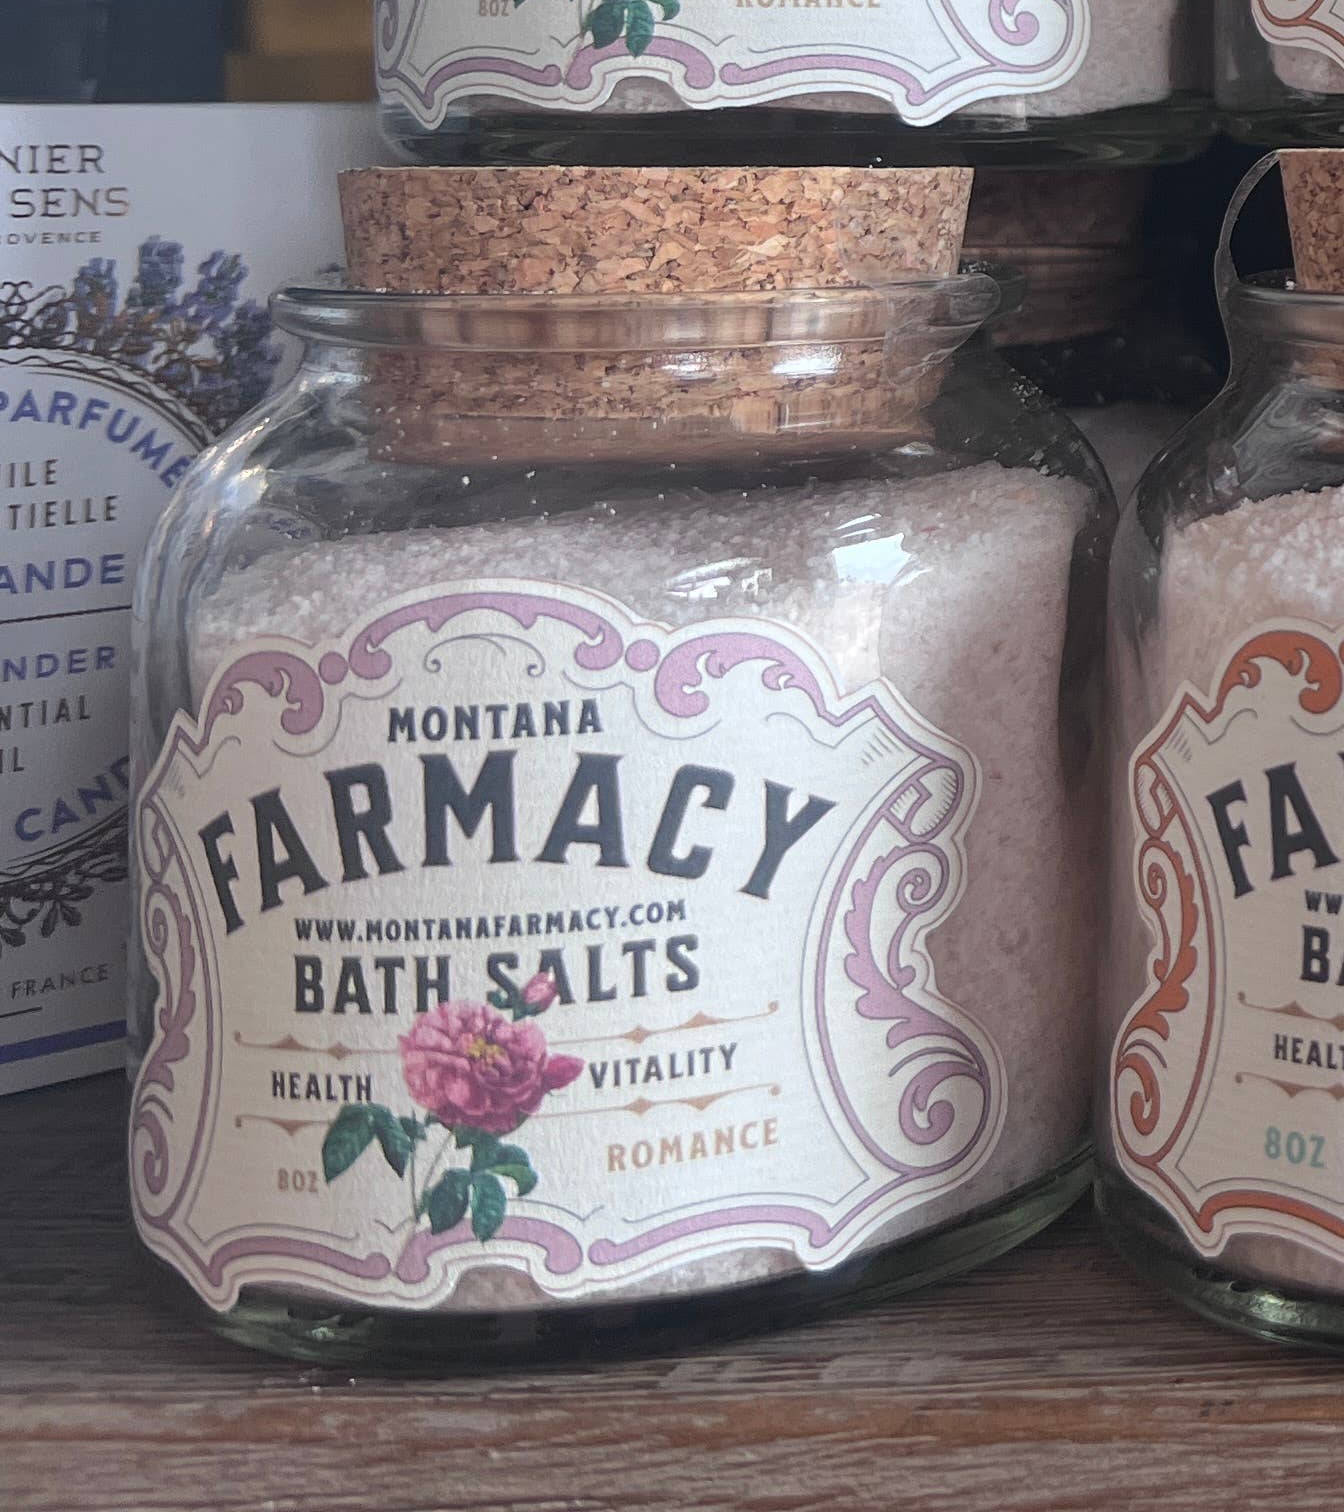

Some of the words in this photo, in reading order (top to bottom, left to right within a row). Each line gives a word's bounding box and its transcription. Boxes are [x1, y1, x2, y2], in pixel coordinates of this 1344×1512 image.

[10, 187, 130, 218] SENS
[0, 231, 102, 244] OVENCE
[0, 459, 58, 488] ILE
[388, 698, 603, 744] MONTANA
[198, 750, 836, 936] FARMACY
[295, 899, 686, 943] WWW.MONTANAFARMACY.COM
[11, 963, 109, 999] FRANCE
[294, 954, 451, 1014] BATH
[486, 934, 699, 1012] SALTS
[271, 1071, 372, 1103] HEALTH
[589, 1042, 737, 1089] VITALITY
[607, 1117, 779, 1172] ROMANCE
[1264, 1125, 1326, 1168] 8OZ
